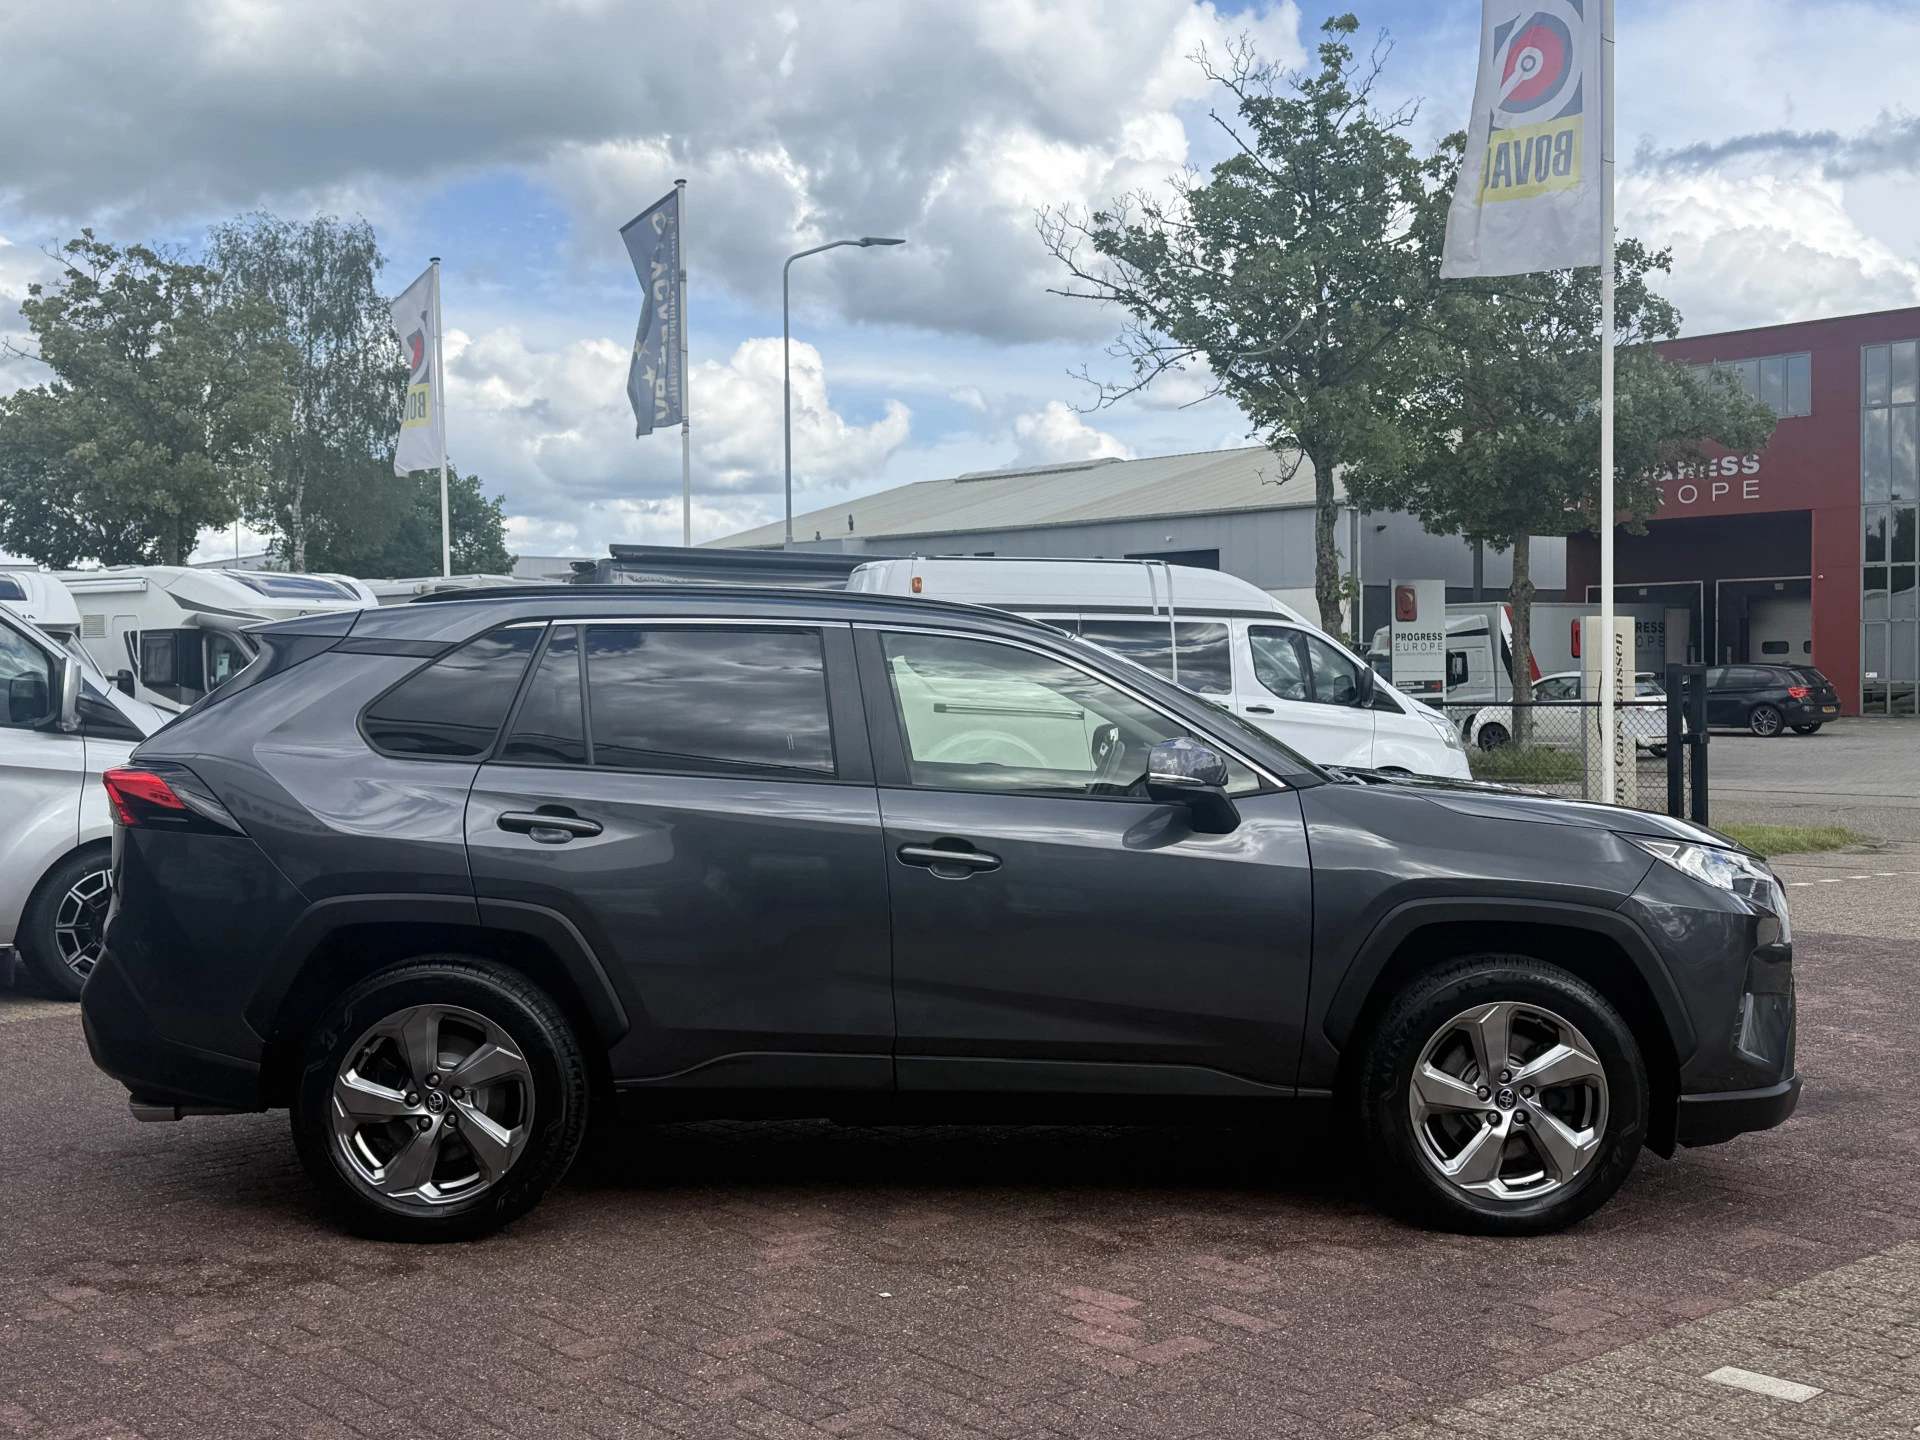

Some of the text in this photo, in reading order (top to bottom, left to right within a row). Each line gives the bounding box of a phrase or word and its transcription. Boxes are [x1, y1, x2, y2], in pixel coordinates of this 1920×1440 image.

[1635, 621, 1665, 634] RESS
[1395, 632, 1443, 641] PROGRESS
[1635, 635, 1665, 648] OPE
[1395, 642, 1443, 652] EUROPE
[1614, 719, 1625, 767] Cars
